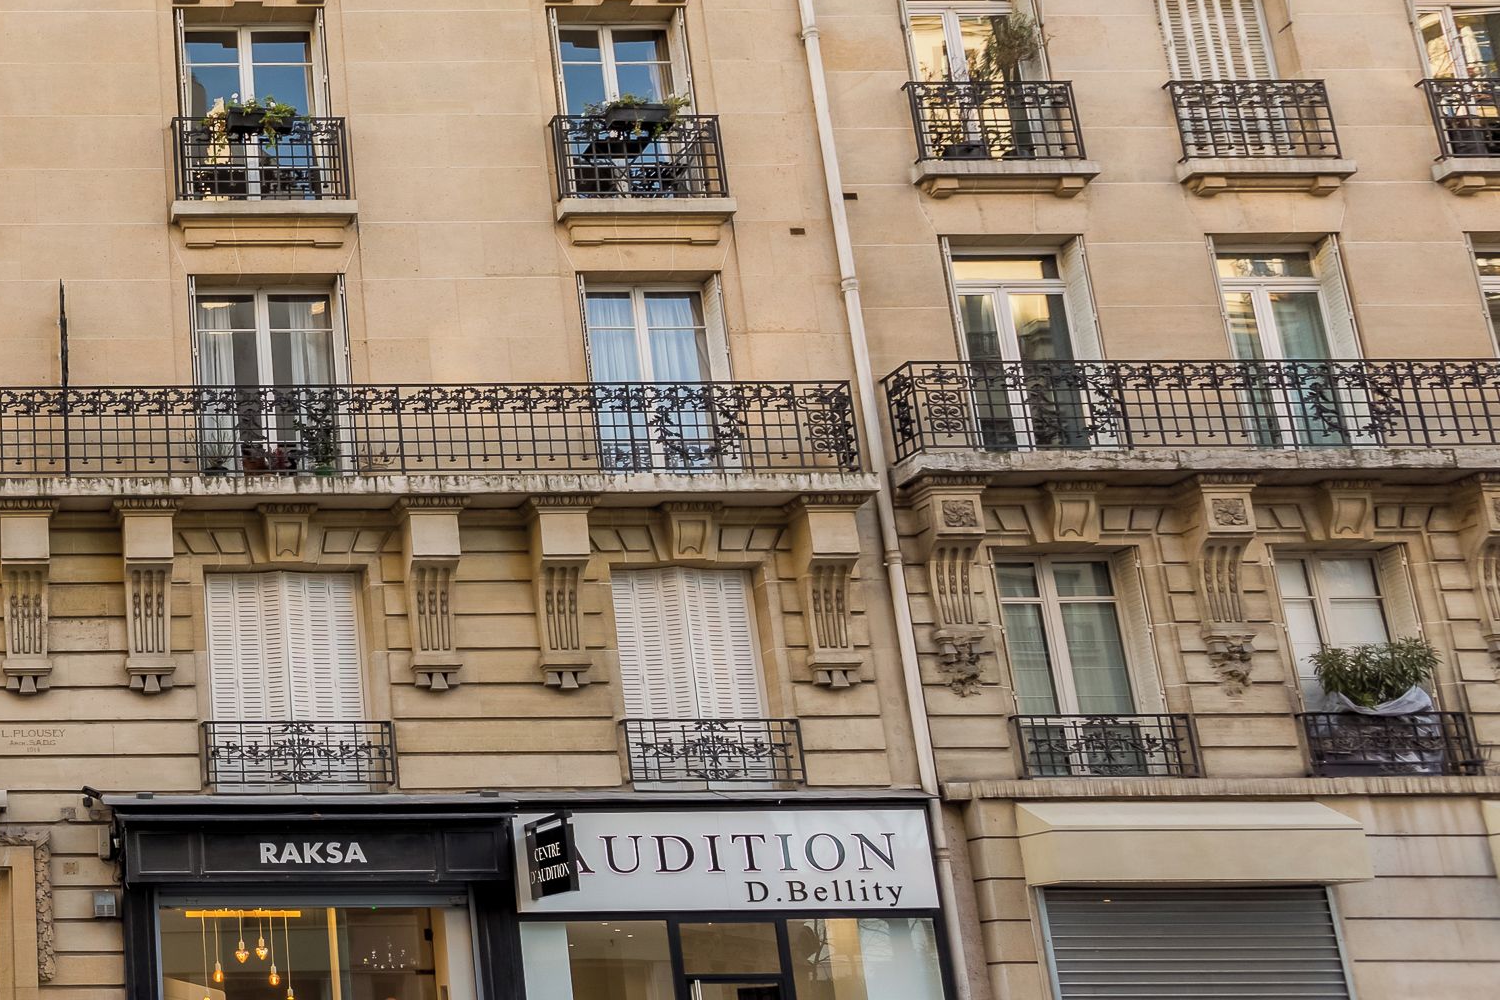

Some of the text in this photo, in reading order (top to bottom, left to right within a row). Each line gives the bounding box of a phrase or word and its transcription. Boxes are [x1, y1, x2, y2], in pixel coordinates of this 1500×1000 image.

[259, 842, 368, 864] RAKSA
[534, 842, 561, 862] CENTRE
[530, 862, 570, 885] D'AUDITION
